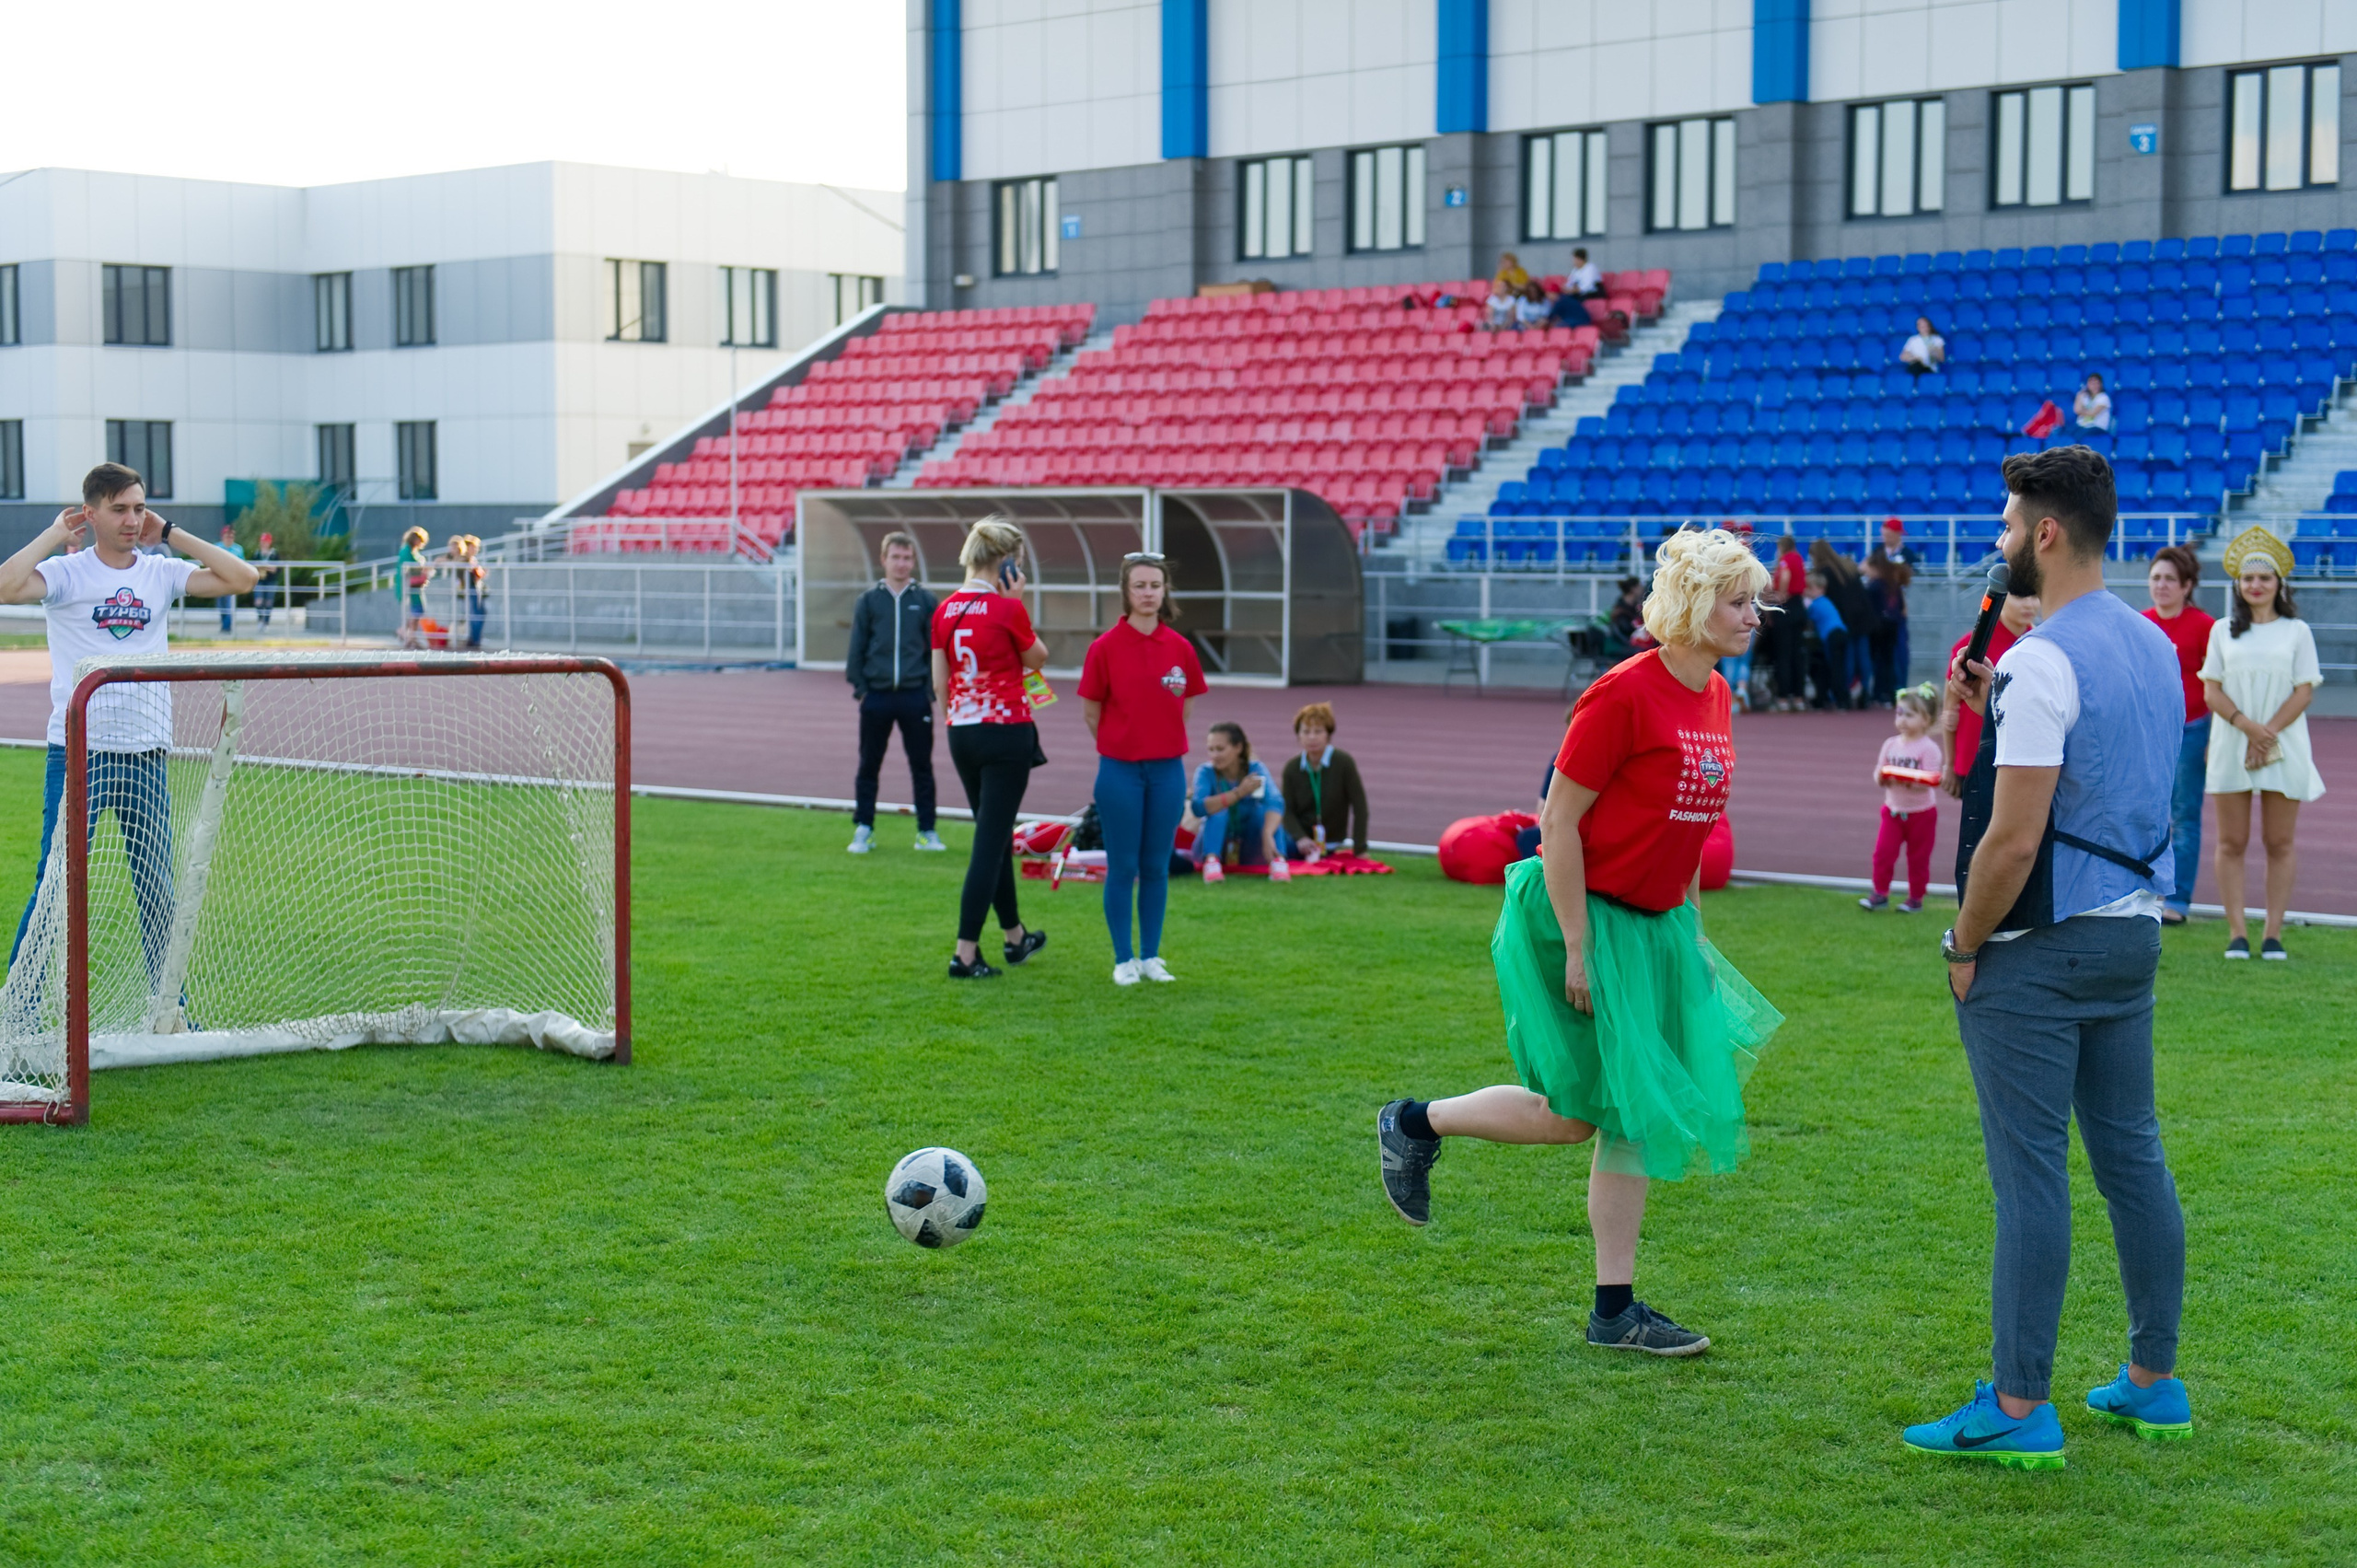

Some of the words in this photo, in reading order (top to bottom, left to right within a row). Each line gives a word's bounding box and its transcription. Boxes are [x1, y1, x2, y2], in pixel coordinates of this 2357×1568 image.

[2139, 135, 2150, 152] 3
[97, 607, 149, 620] ТУРБО
[944, 600, 988, 619] ДЕМИНА
[953, 628, 979, 686] 5
[1669, 809, 1710, 823] FASHION
